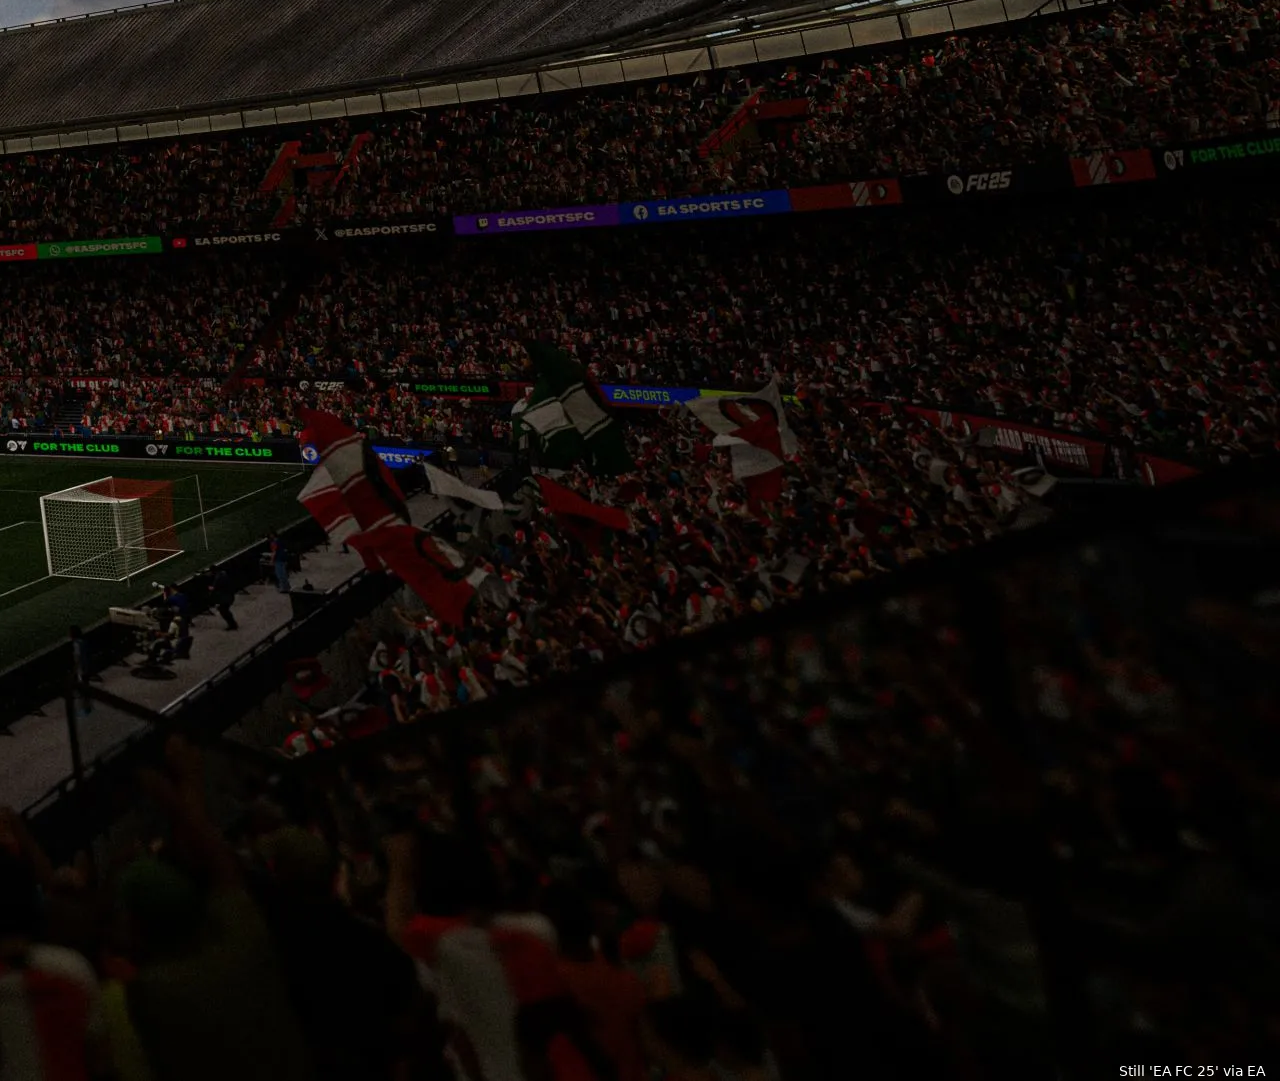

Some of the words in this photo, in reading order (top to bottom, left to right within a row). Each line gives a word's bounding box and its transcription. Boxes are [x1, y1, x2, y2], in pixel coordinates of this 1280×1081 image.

[1190, 148, 1217, 164] FOR
[1218, 143, 1246, 159] THE
[1246, 138, 1280, 155] CLUB
[966, 170, 1012, 192] FC25
[658, 206, 677, 216] EA
[679, 200, 741, 214] SPORTS
[743, 198, 764, 208] FC
[498, 212, 595, 227] EASPORTSFC
[334, 223, 436, 238] @EASPORTSFC
[194, 237, 211, 246] EA
[212, 234, 262, 244] SPORTS
[264, 233, 281, 242] FC
[65, 242, 147, 252] @EASPORTSFC
[415, 384, 436, 392] FOR
[438, 384, 458, 392] THE
[460, 384, 490, 393] CLUB
[614, 388, 629, 400] EA
[630, 389, 670, 402] SPORTS
[34, 442, 59, 451] FOR
[60, 442, 84, 452] THE
[86, 443, 120, 452] CLUB
[176, 446, 204, 455] FOR
[205, 447, 233, 456] THE
[235, 448, 272, 457] CLUB
